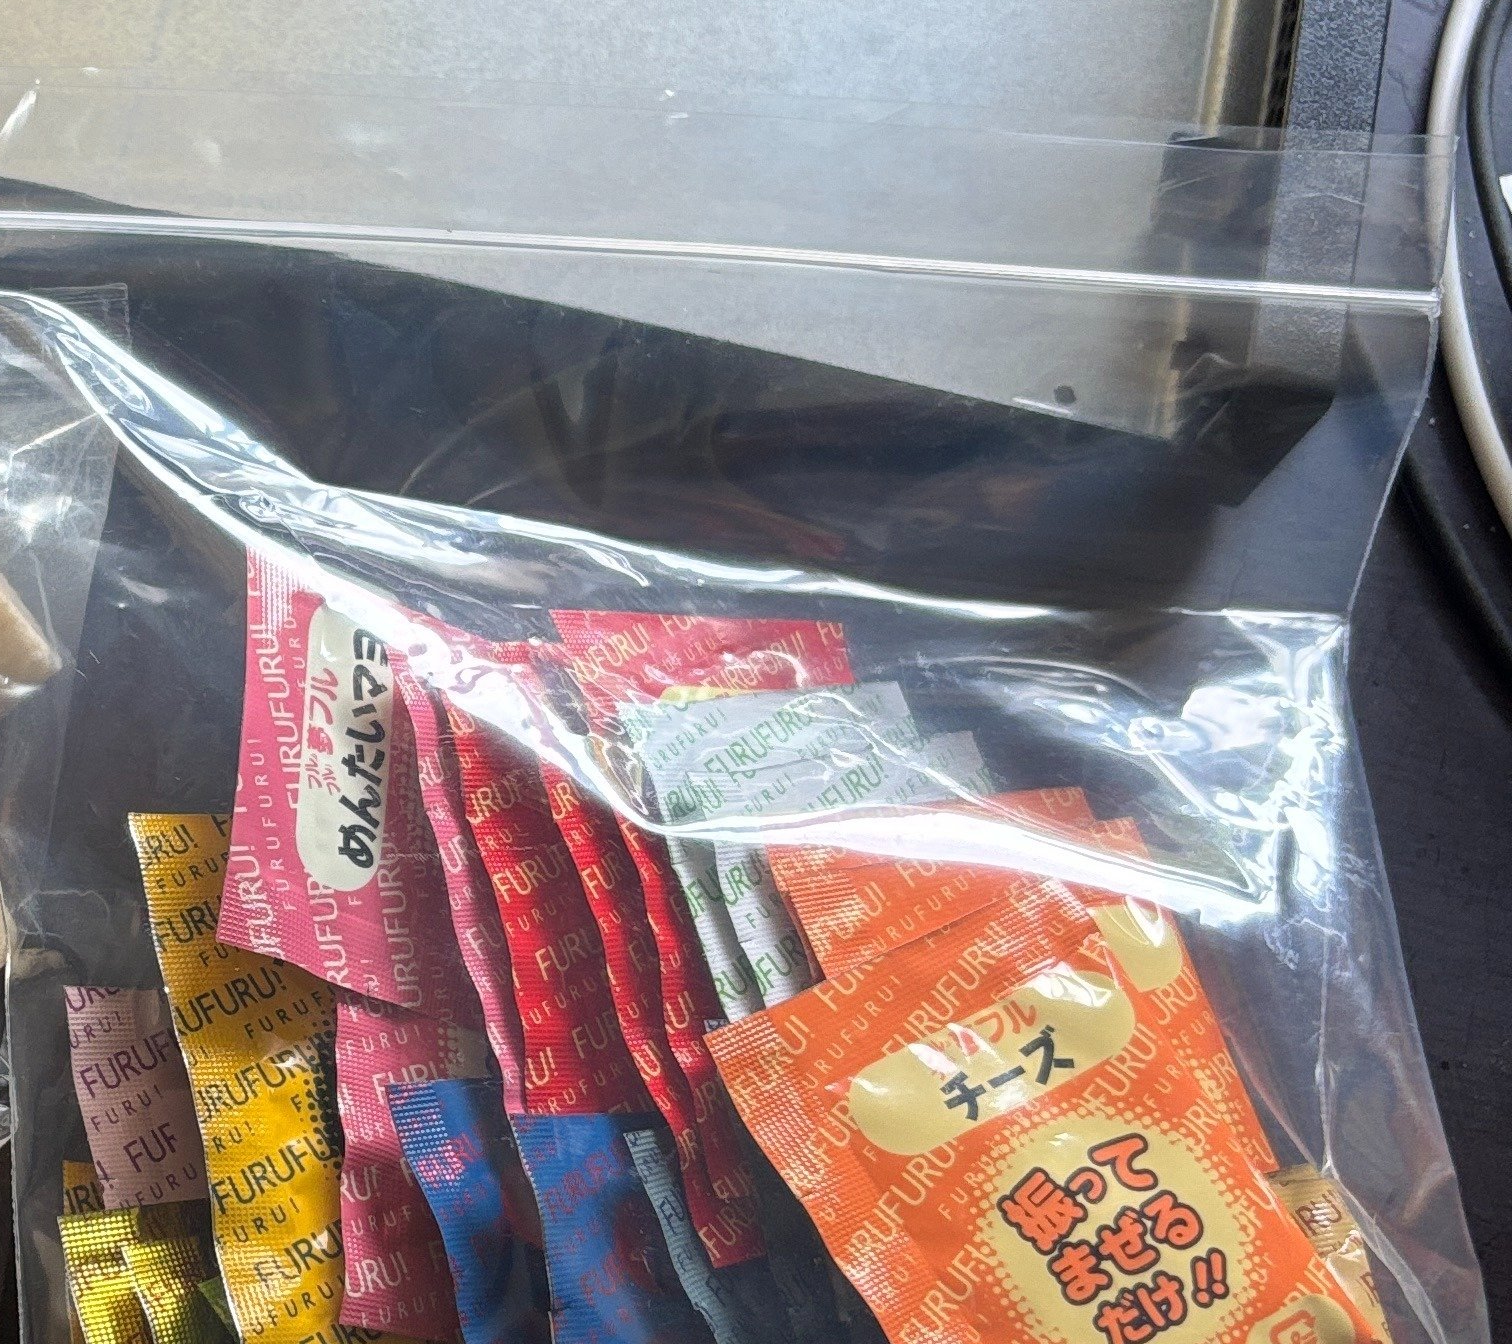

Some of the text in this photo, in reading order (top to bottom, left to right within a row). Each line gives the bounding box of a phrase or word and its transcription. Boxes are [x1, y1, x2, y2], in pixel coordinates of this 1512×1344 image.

[336, 627, 389, 870] めんたいマヨ
[940, 1024, 1076, 1121] チーズ
[995, 1131, 1160, 1255] 振って
[1046, 1188, 1205, 1306] まぜる
